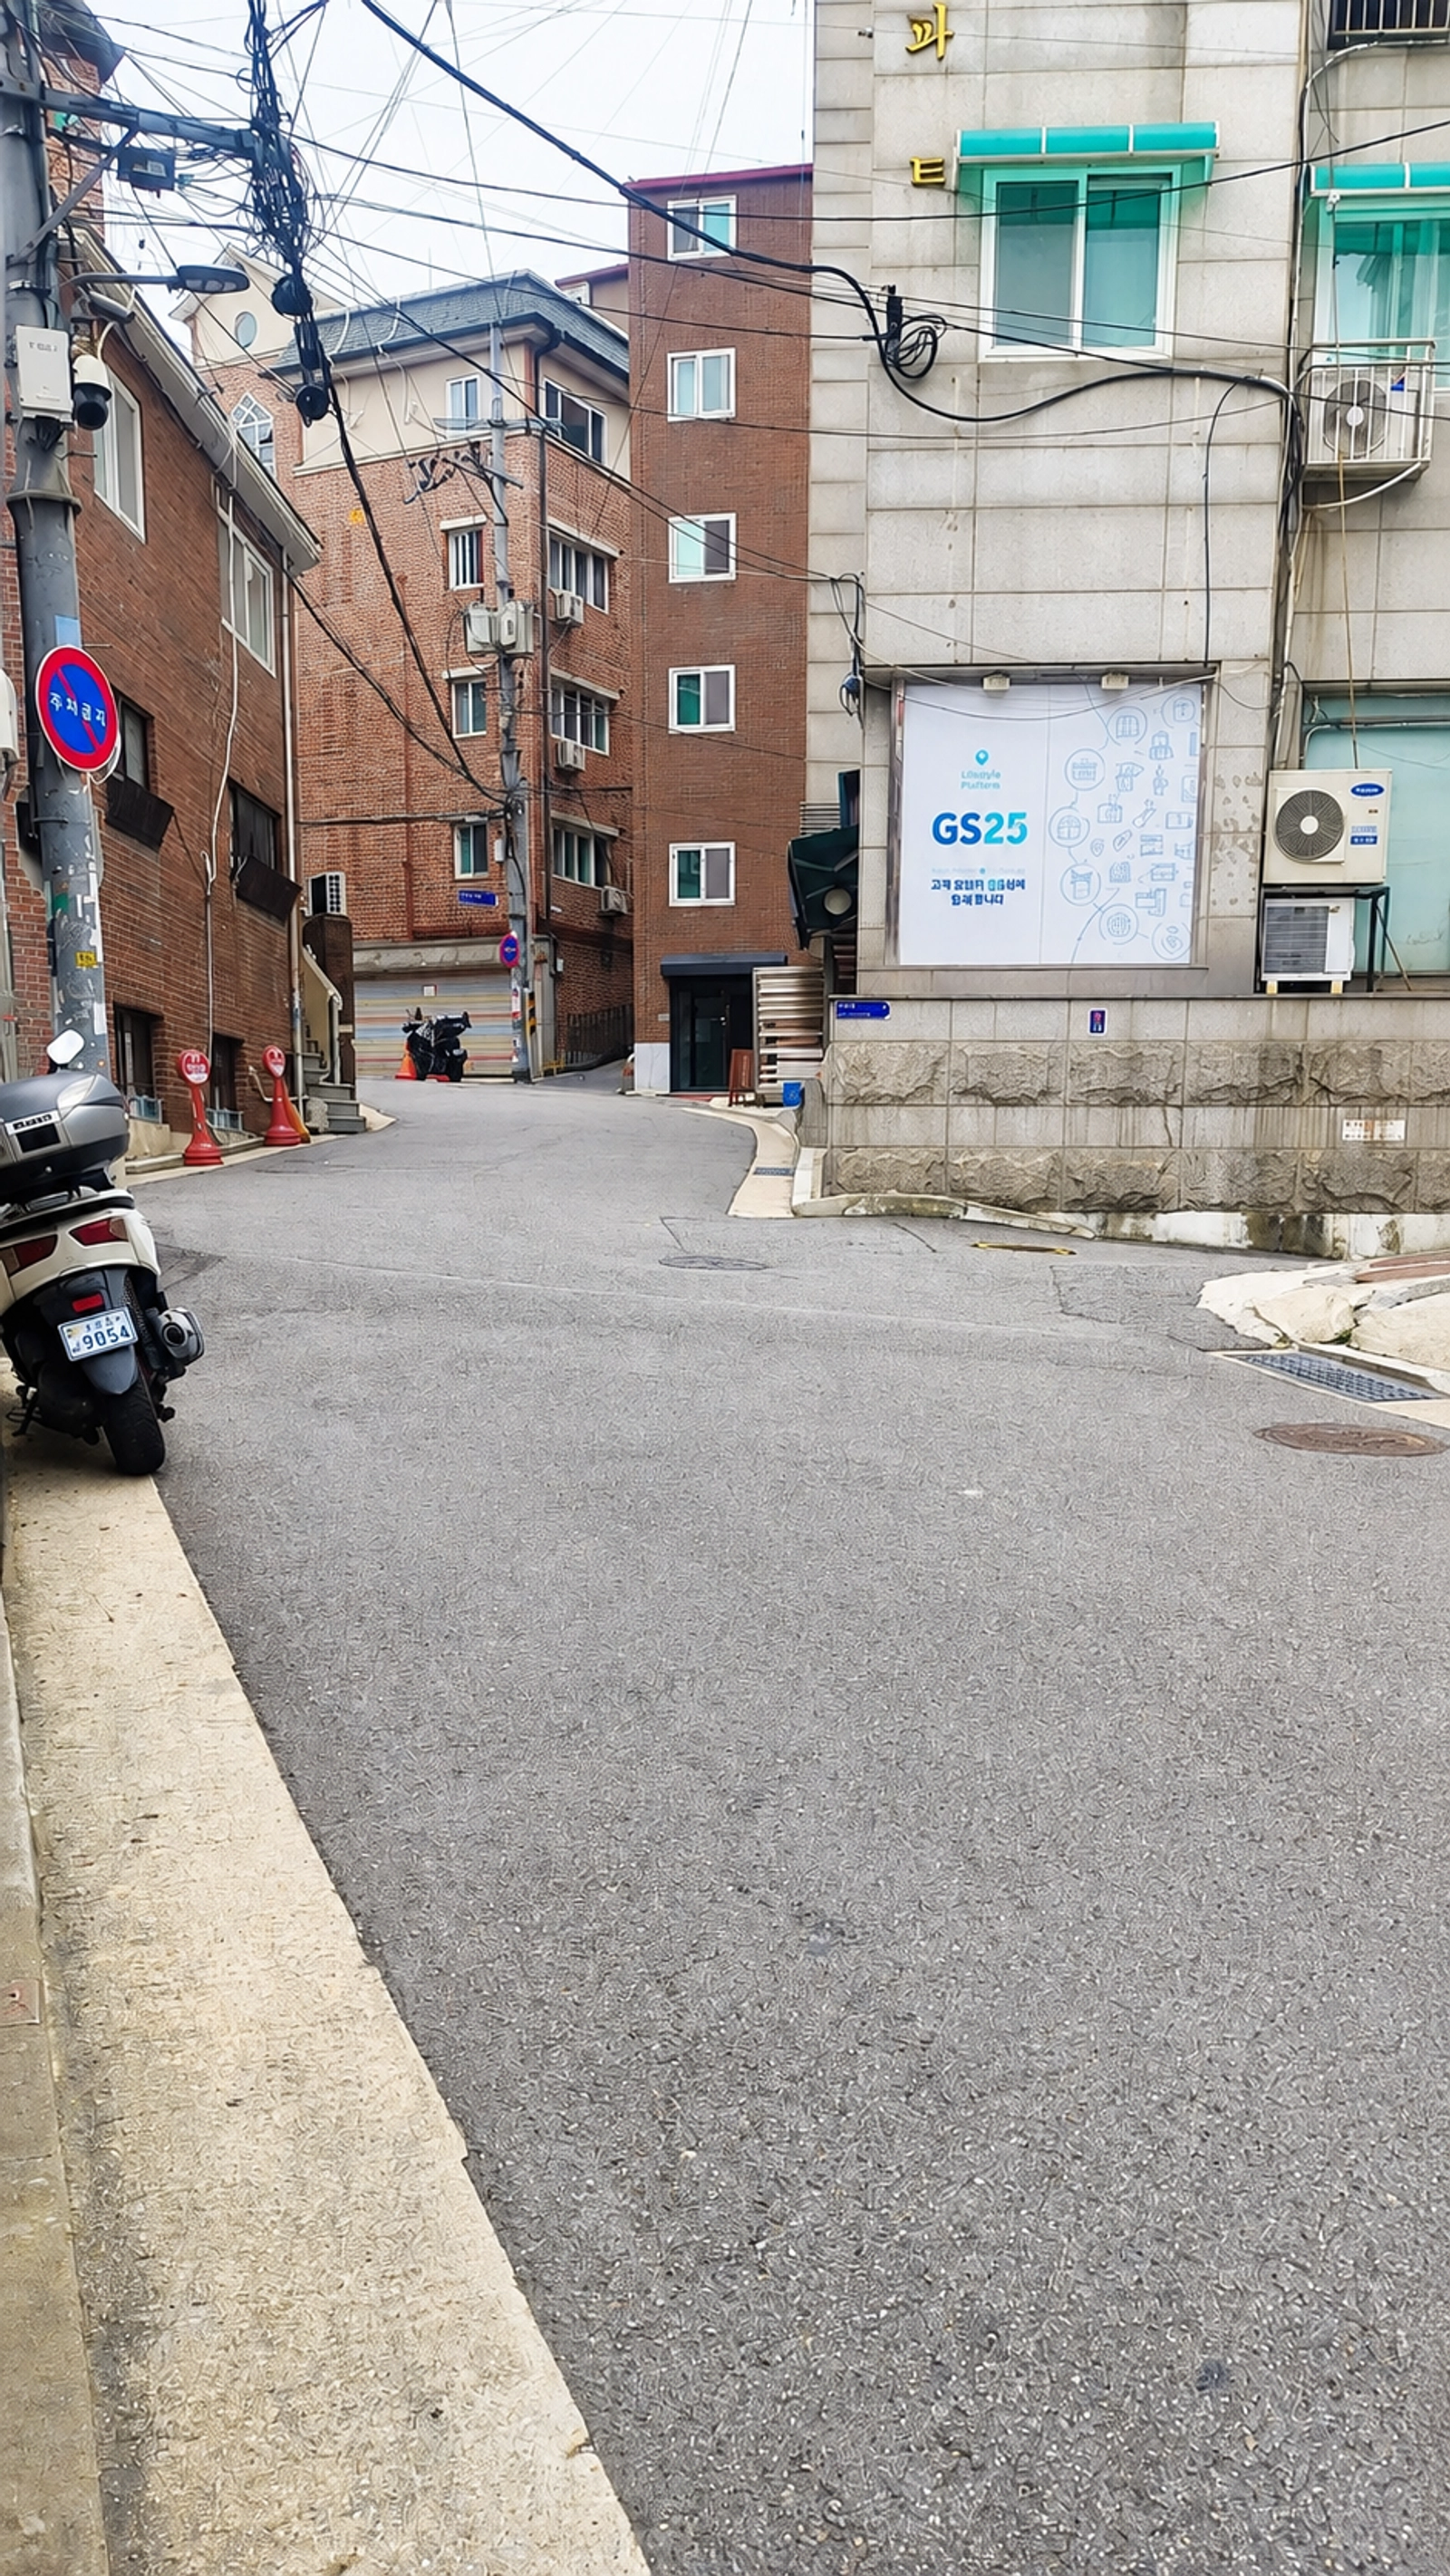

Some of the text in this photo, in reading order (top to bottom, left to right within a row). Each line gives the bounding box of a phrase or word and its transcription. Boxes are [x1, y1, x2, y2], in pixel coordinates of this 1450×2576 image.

[49, 691, 106, 727] 주차금지
[932, 811, 1028, 845] GS25
[82, 1325, 130, 1349] 9054
